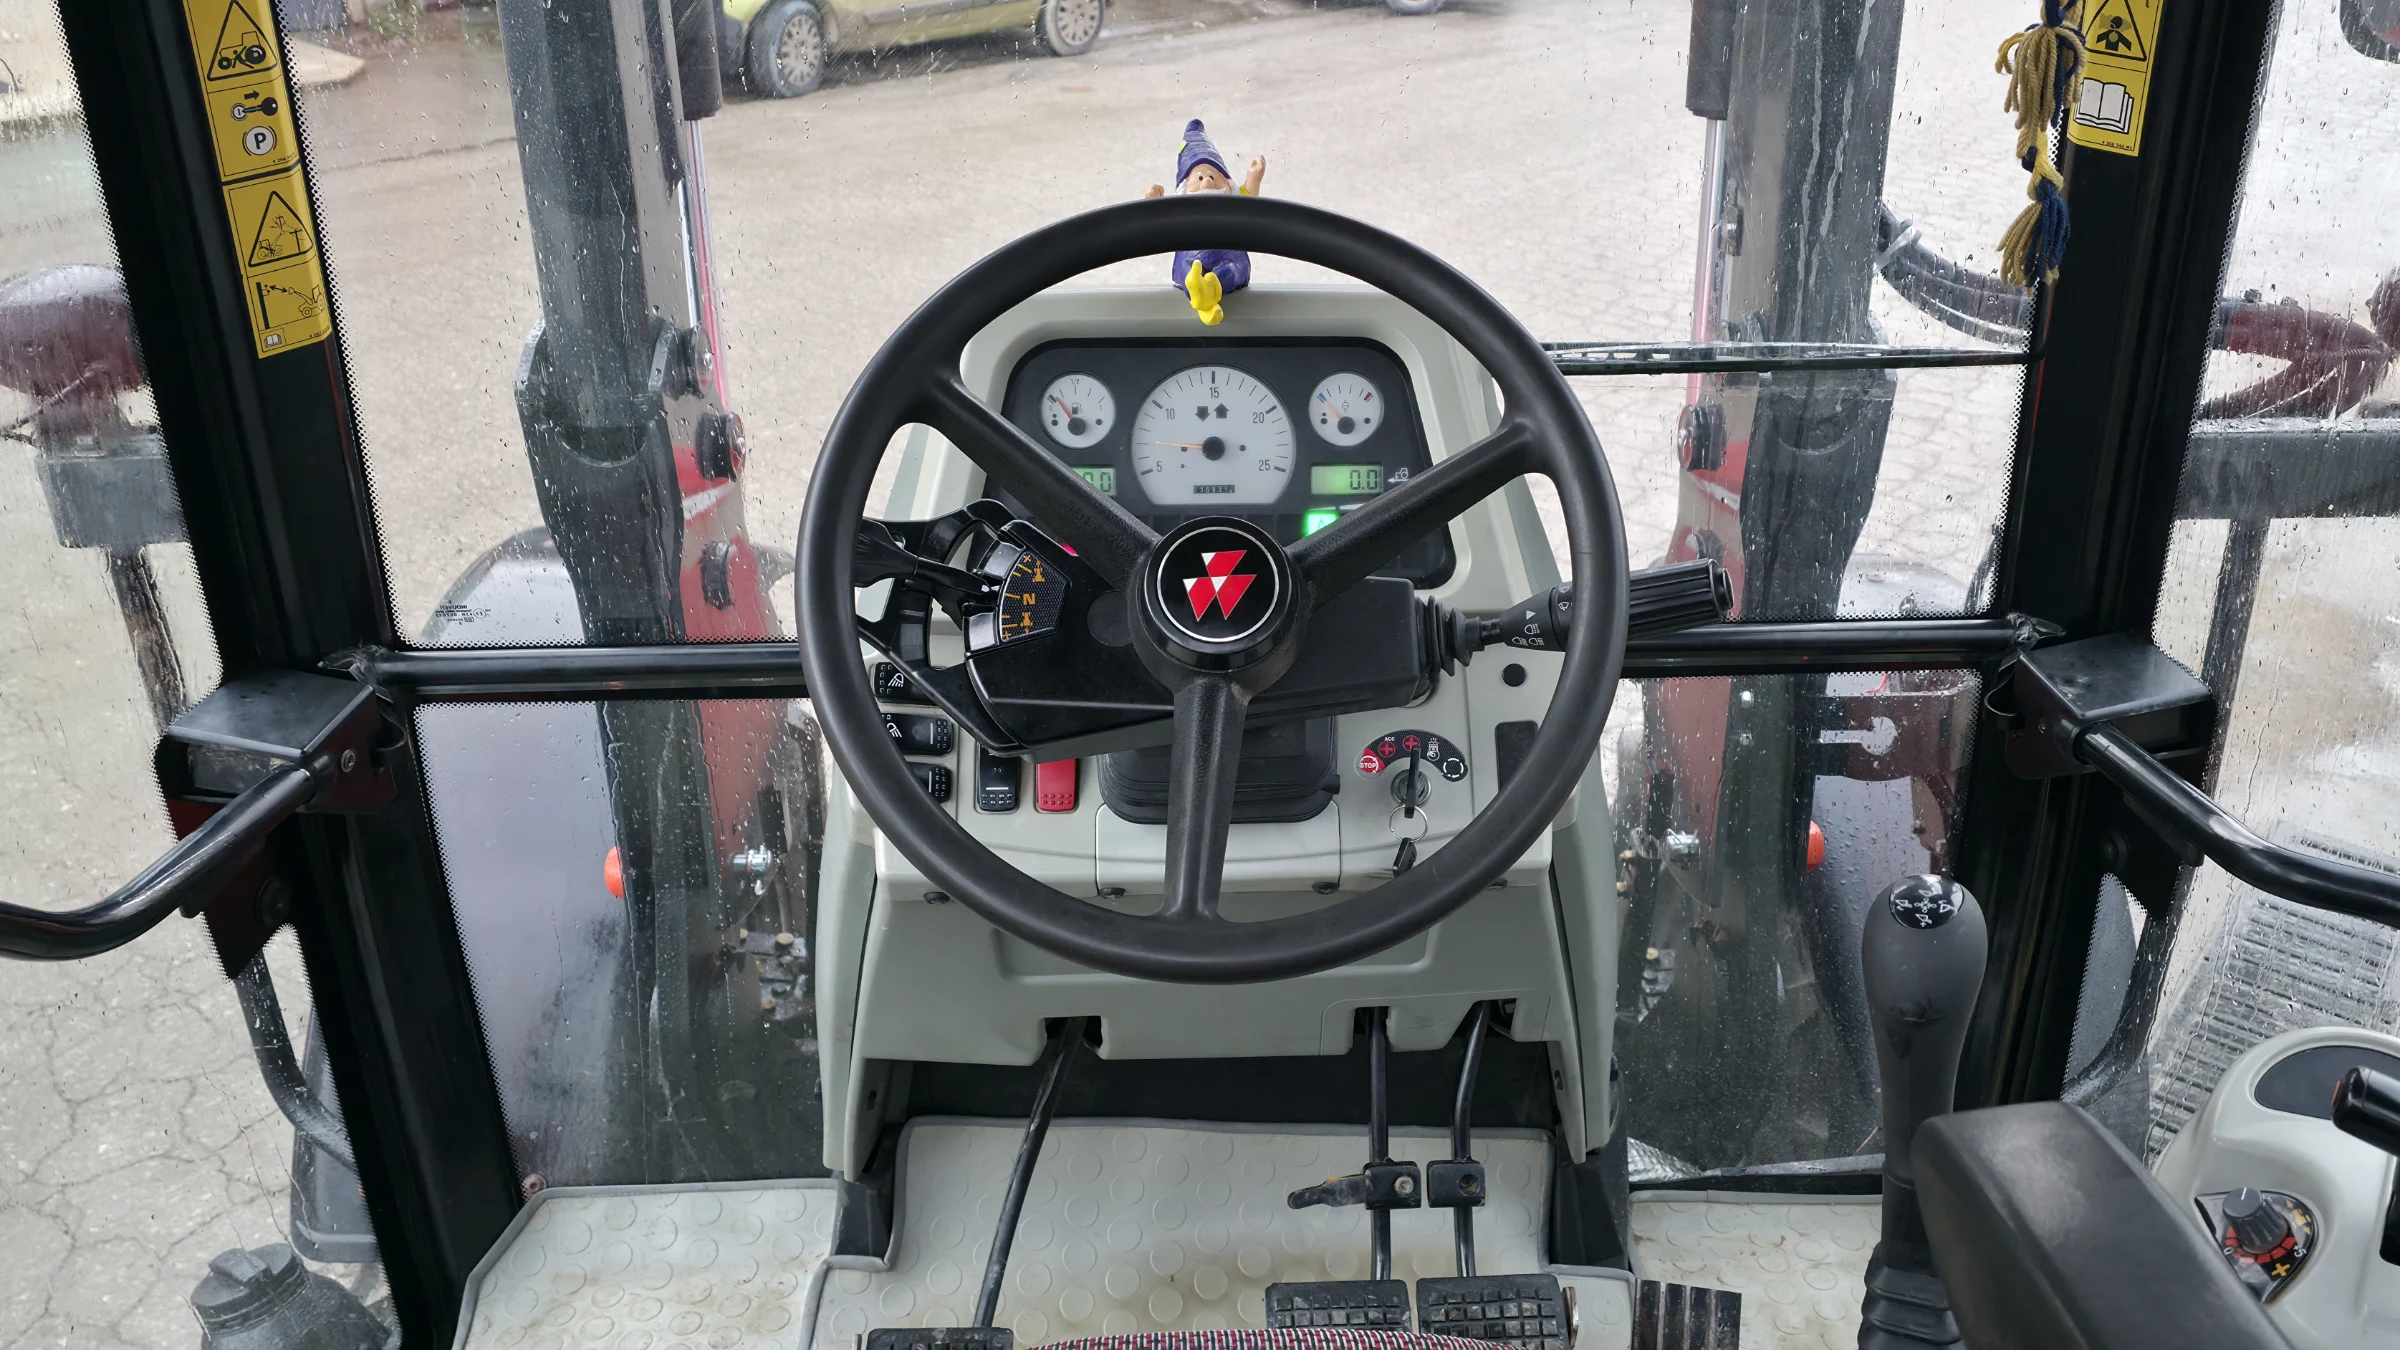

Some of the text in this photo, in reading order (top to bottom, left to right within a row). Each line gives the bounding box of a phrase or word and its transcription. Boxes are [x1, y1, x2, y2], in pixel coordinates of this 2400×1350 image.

[253, 132, 267, 150] P
[1209, 387, 1219, 399] 15
[1165, 408, 1175, 420] 10
[1252, 411, 1265, 424] 20
[1156, 460, 1162, 473] 5
[1258, 459, 1271, 471] 25
[1349, 469, 1378, 490] 0.0
[1023, 593, 1036, 605] N
